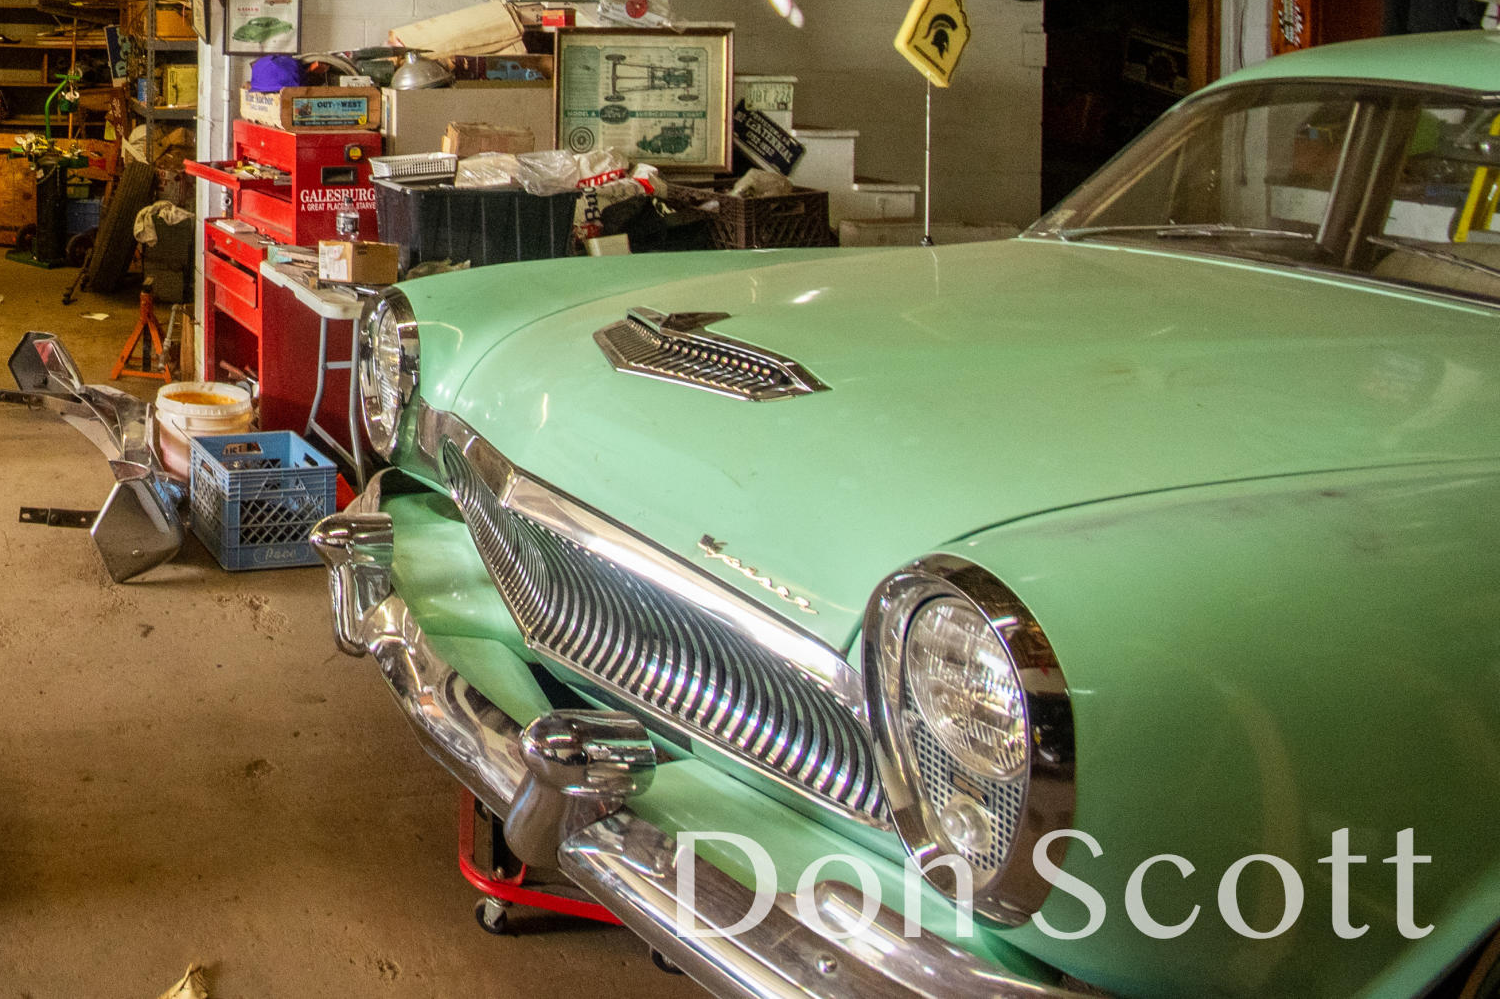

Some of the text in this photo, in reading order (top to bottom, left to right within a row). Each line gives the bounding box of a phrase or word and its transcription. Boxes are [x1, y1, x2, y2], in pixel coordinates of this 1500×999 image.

[341, 101, 363, 109] WEST
[300, 188, 376, 204] GALESBURG
[300, 203, 306, 212] A
[307, 202, 325, 212] GREAT
[355, 201, 377, 210] STARVE
